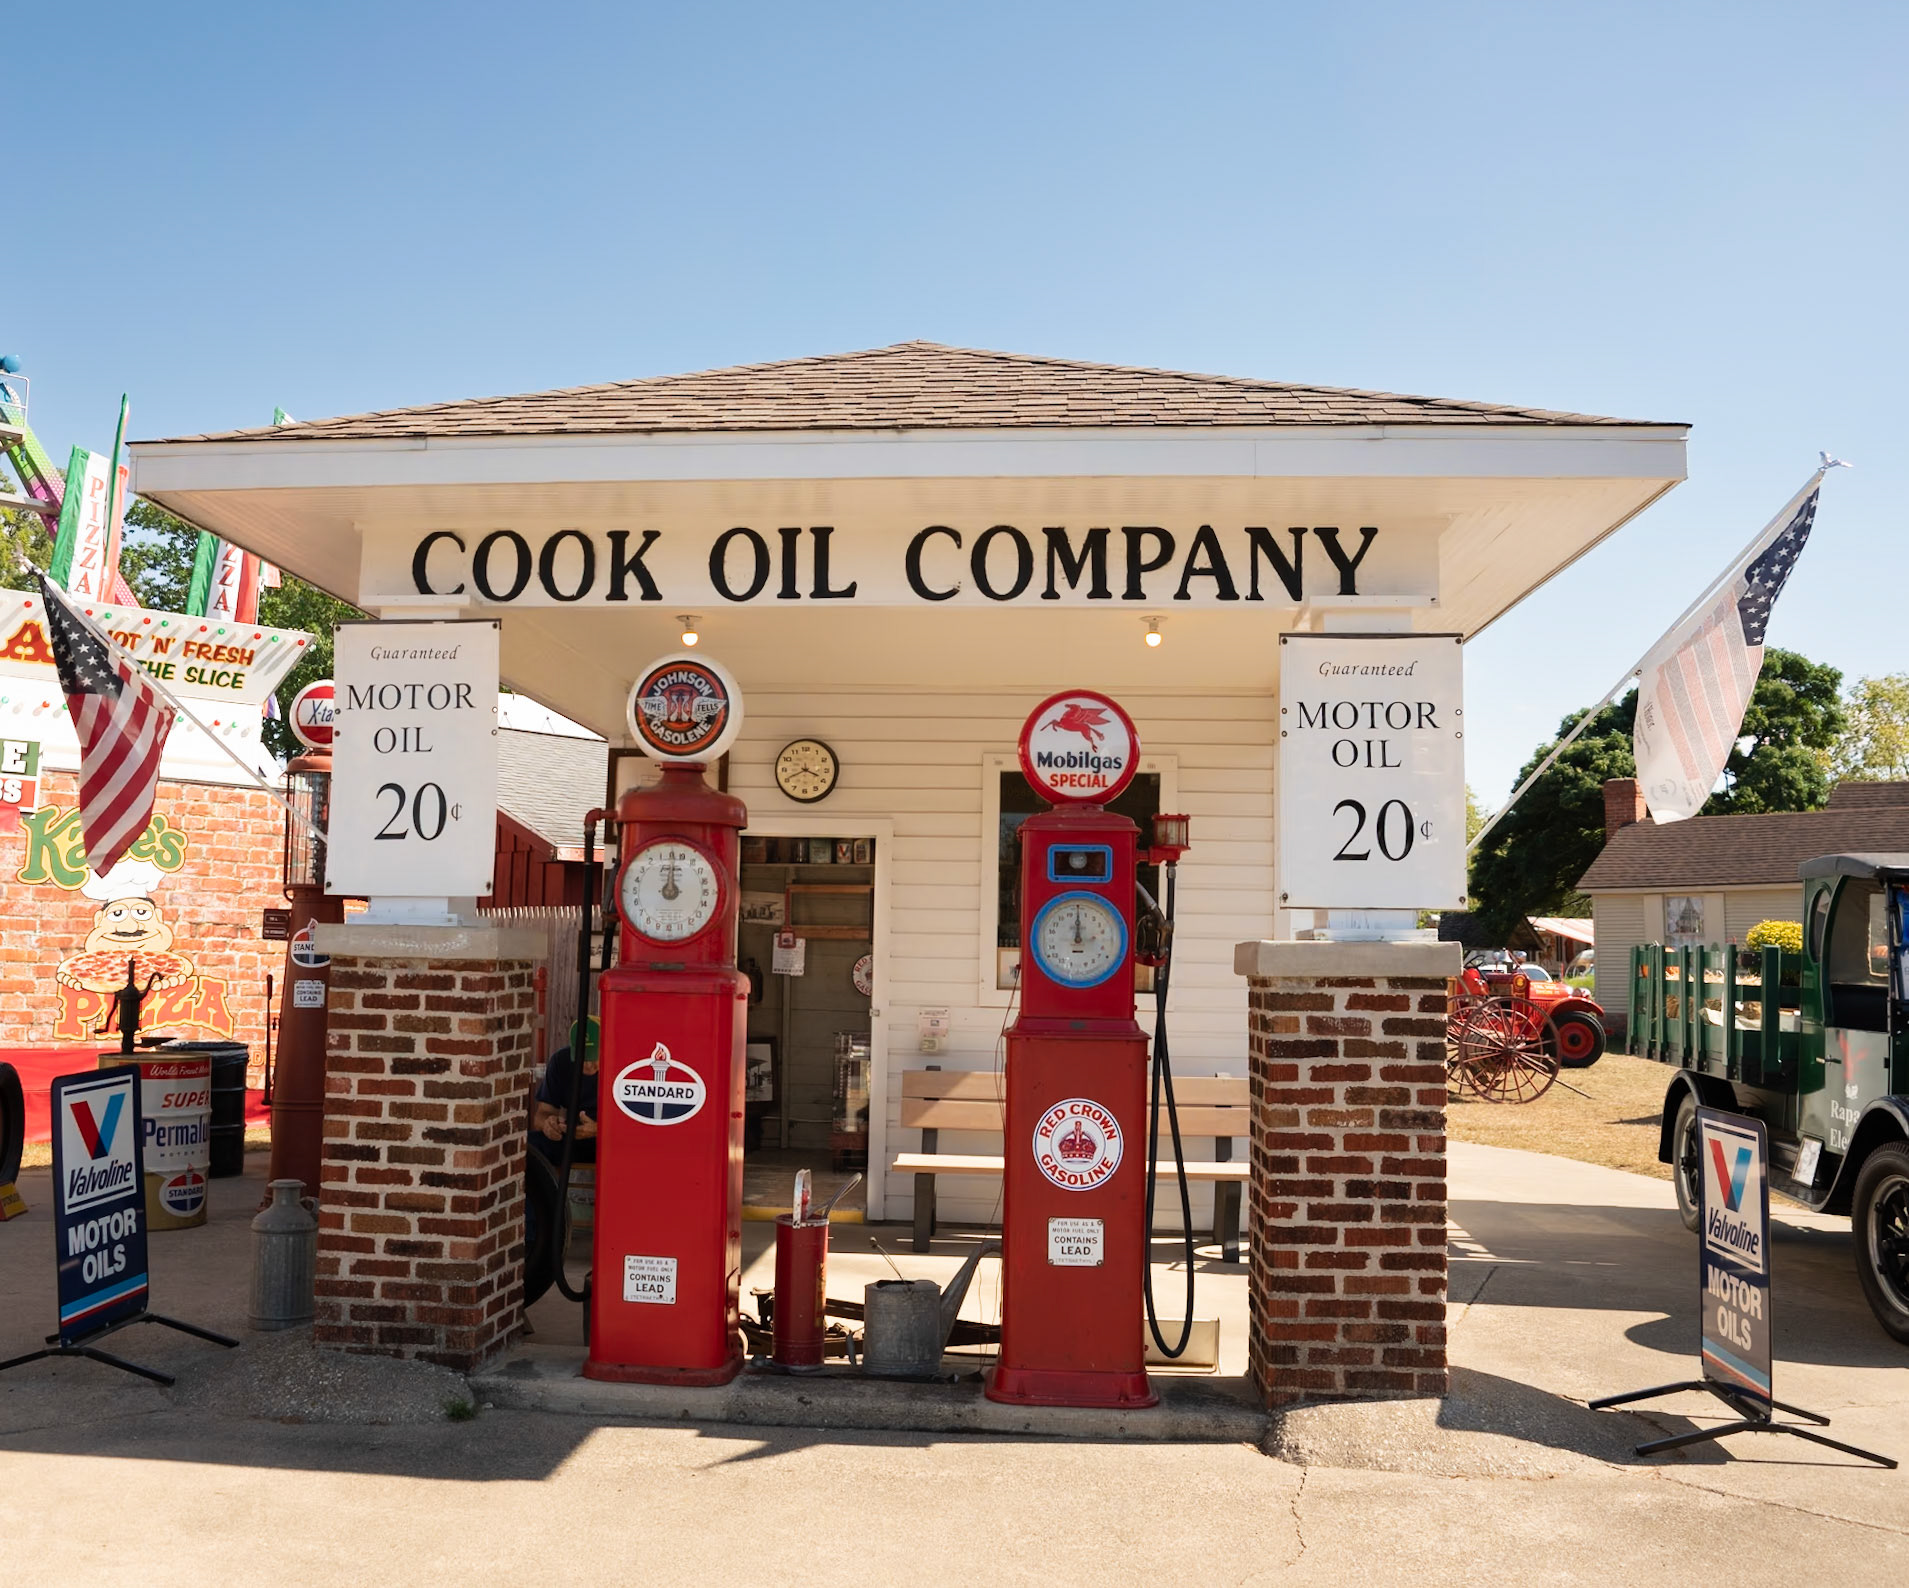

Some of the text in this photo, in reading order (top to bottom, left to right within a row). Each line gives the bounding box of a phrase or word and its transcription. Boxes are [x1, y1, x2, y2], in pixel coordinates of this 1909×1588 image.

[74, 476, 104, 595] PIZZA
[412, 525, 1378, 601] COOK OIL COMPANY
[213, 541, 241, 612] ZZA
[107, 630, 142, 650] OT
[183, 641, 255, 666] FRESH
[371, 645, 462, 661] Guaranteed
[184, 666, 245, 689] SLICE
[1319, 660, 1419, 677] Guaranteed
[347, 683, 476, 710] MOTOR
[654, 671, 713, 696] JOHNSON
[308, 700, 334, 724] X-ta
[644, 702, 718, 712] TIME TELLS
[1297, 701, 1441, 730] MOTOR
[374, 727, 434, 753] OIL
[650, 720, 711, 744] GASOLENE
[1037, 751, 1122, 774] Mobilgas
[1331, 739, 1403, 768] OIL
[1050, 774, 1109, 788] SPECIAL
[18, 806, 187, 889] Kae's
[624, 1085, 694, 1099] STANDARD
[1039, 1104, 1117, 1141] RED CROWN
[1831, 1100, 1861, 1126] Rapa
[68, 1160, 133, 1198] Valvoline
[1040, 1154, 1114, 1185] GASOLINE
[68, 1208, 136, 1256] MOTOR
[1054, 1236, 1098, 1244] CONTAINS
[1708, 1207, 1760, 1255] Valvoline
[83, 1243, 127, 1284] OILS
[1061, 1246, 1091, 1255] LEAD
[630, 1273, 671, 1282] CONTAINS
[636, 1283, 664, 1293] LEAD
[1708, 1264, 1763, 1320] MOTOR
[1717, 1305, 1752, 1351] OILS
